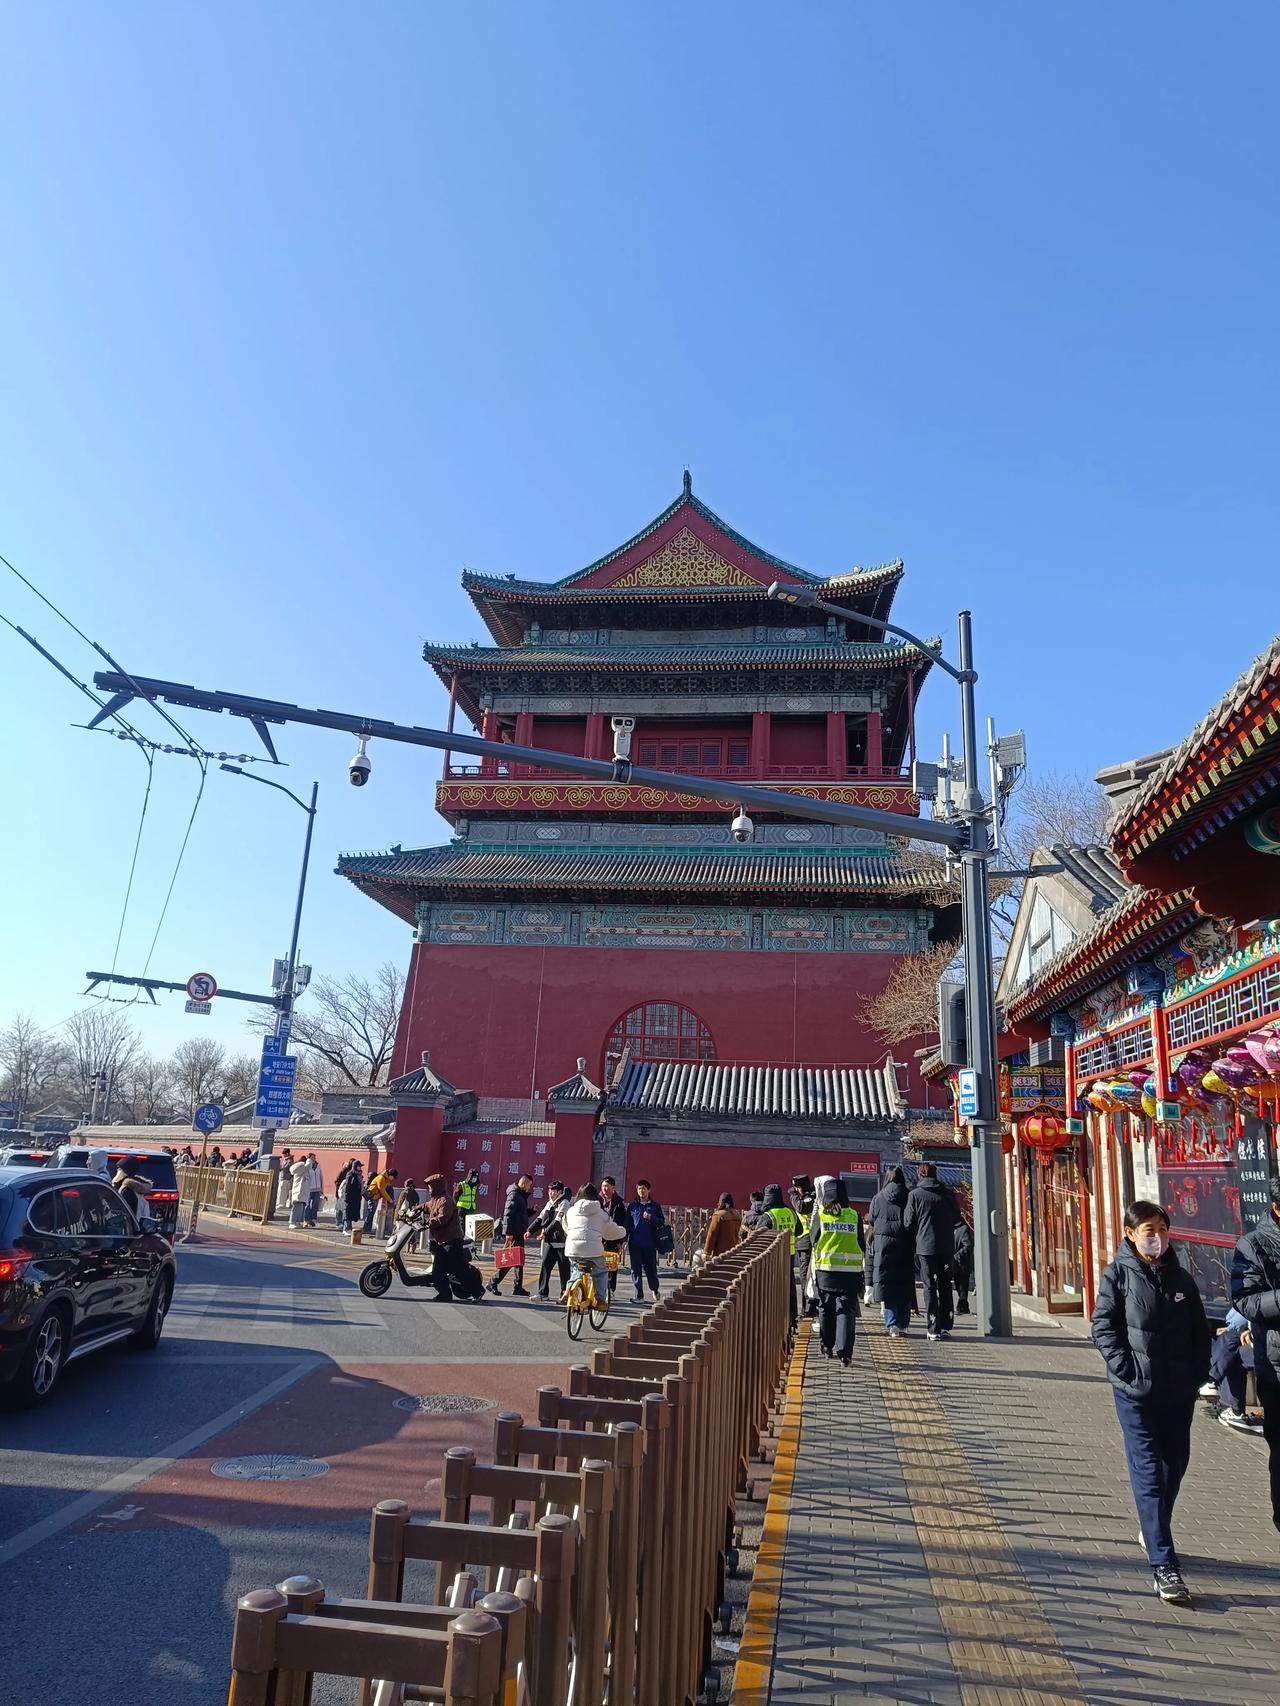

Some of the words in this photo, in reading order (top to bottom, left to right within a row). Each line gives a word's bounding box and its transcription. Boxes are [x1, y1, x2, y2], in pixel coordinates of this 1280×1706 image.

[456, 1139, 546, 1154] 消防通道
[454, 1160, 545, 1176] 生命通道
